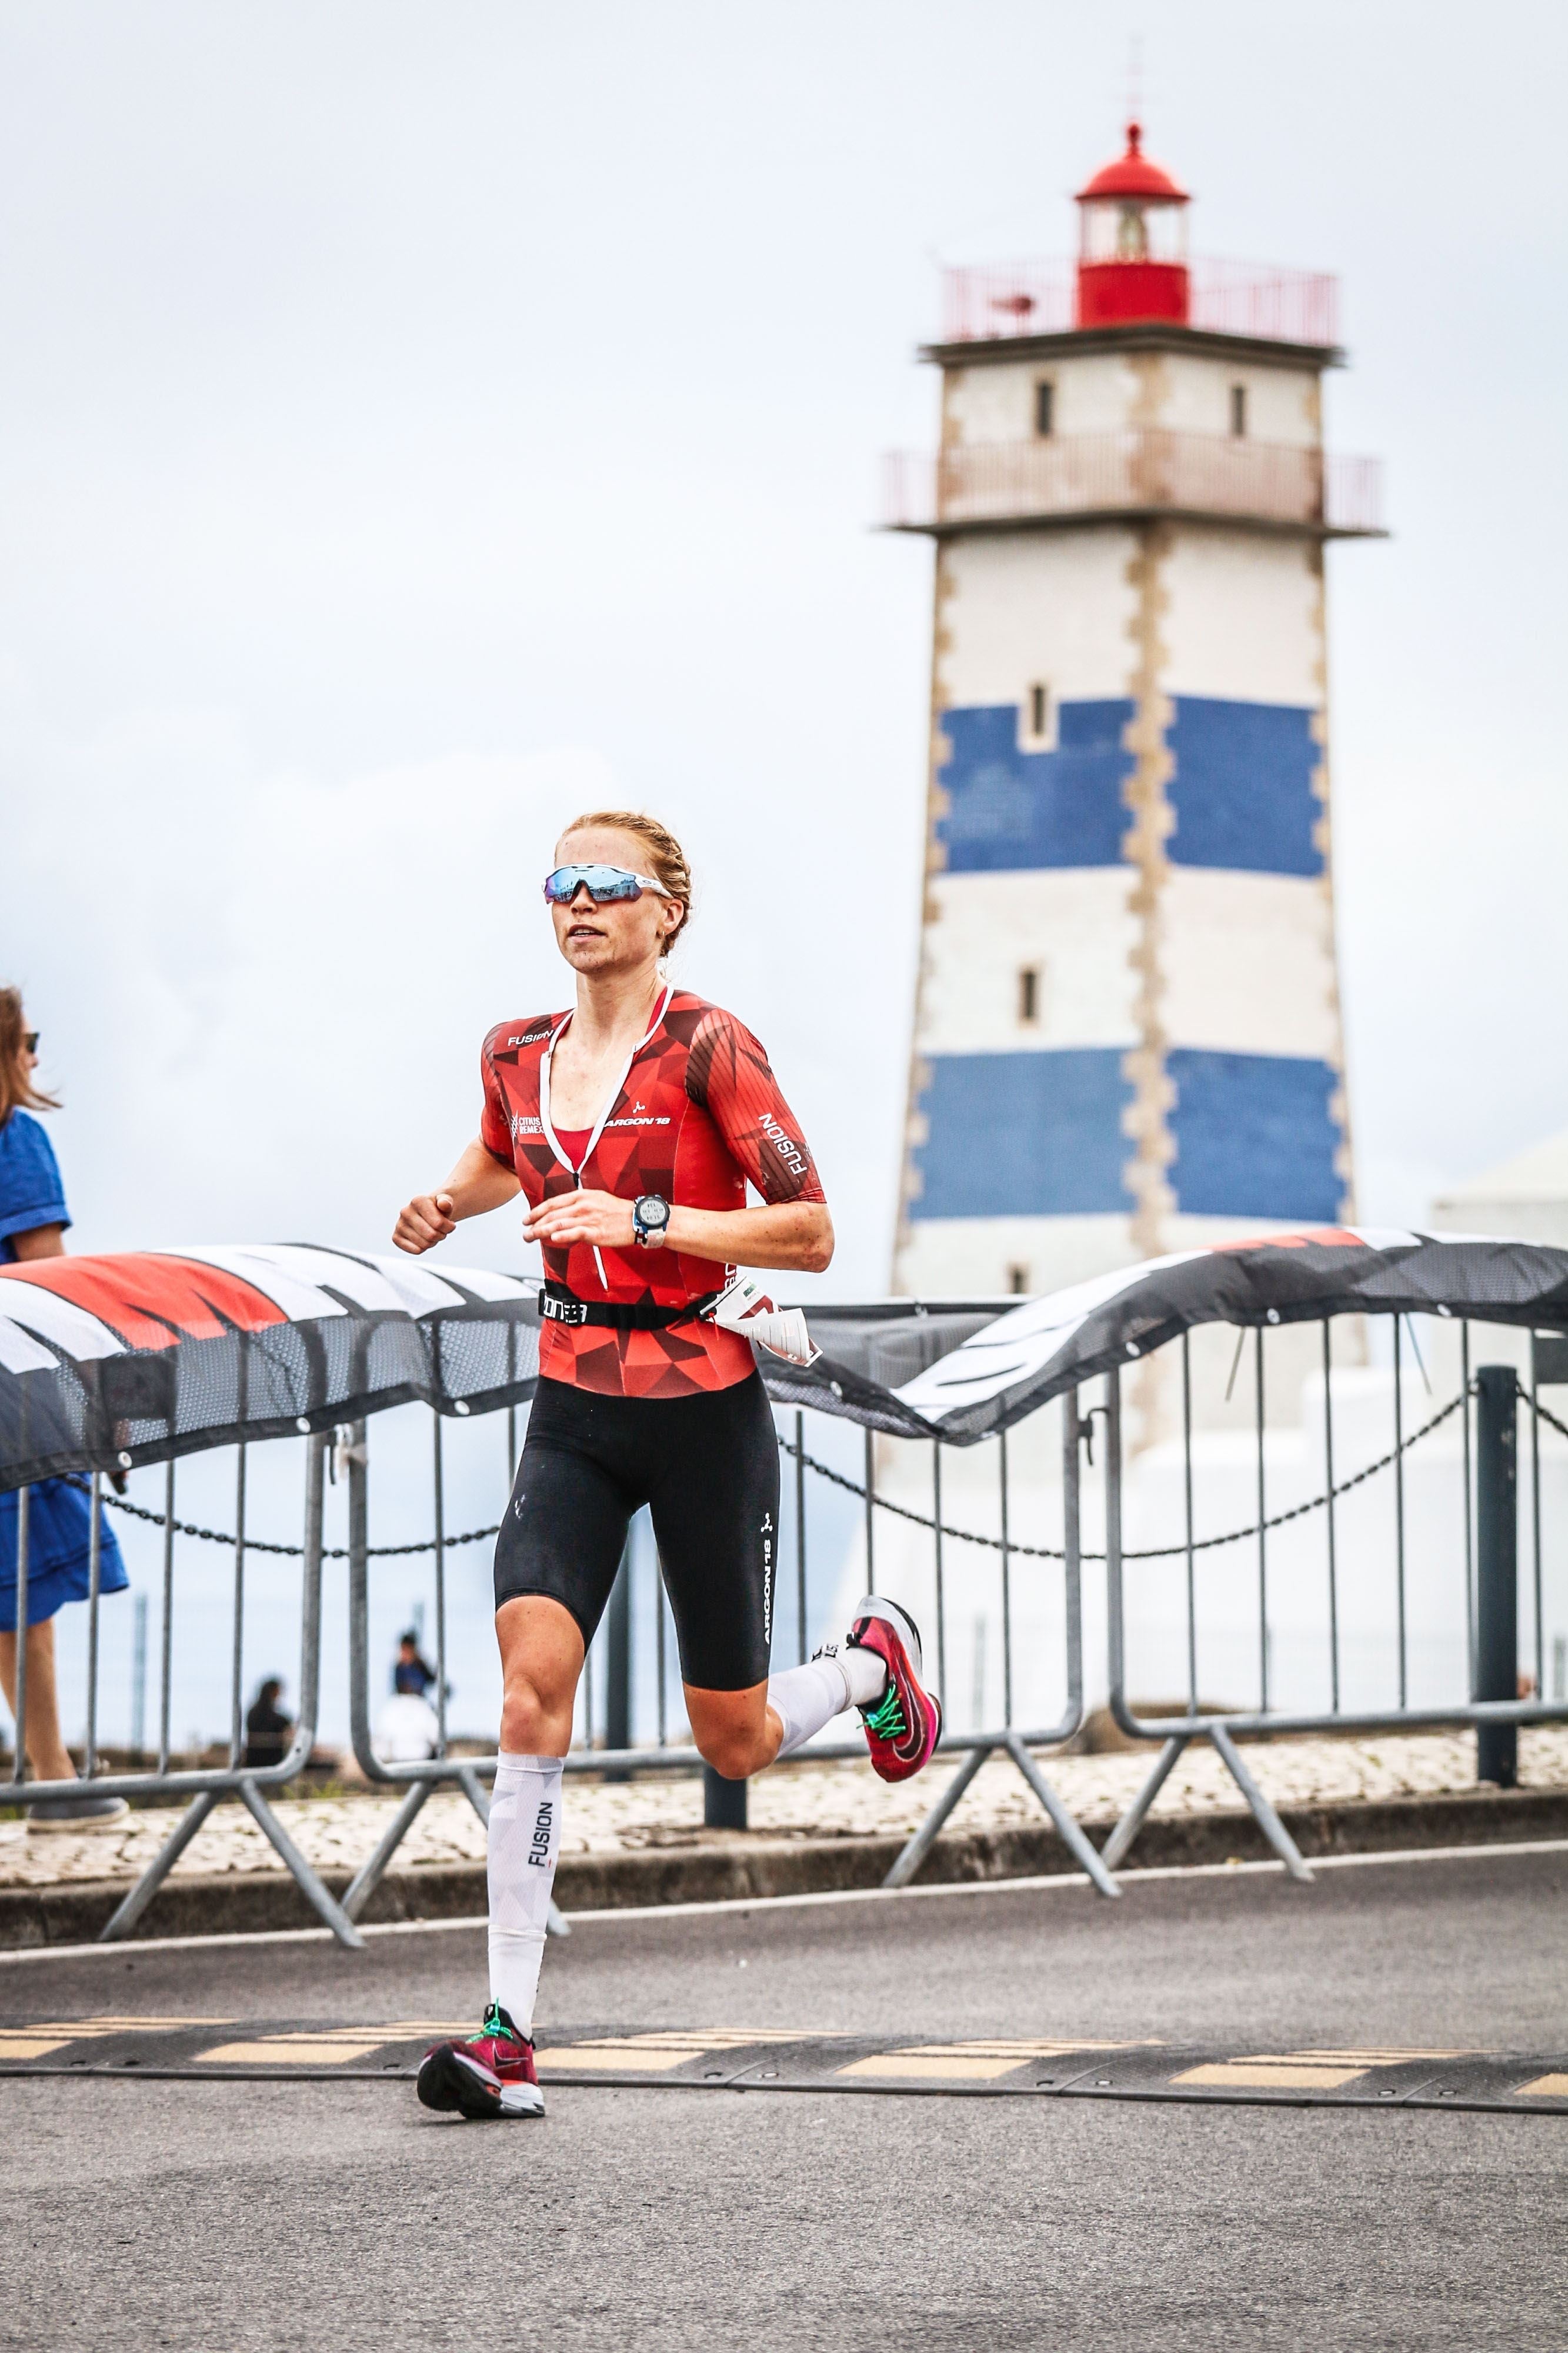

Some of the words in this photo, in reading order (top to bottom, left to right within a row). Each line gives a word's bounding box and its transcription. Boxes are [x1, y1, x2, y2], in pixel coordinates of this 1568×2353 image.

[508, 1029, 554, 1046] FUSION
[518, 1116, 542, 1126] CITIUS
[603, 1117, 654, 1128] ARGON
[758, 1113, 808, 1175] FUSION
[764, 1539, 771, 1564] 18
[528, 1802, 551, 1867] FUSION
